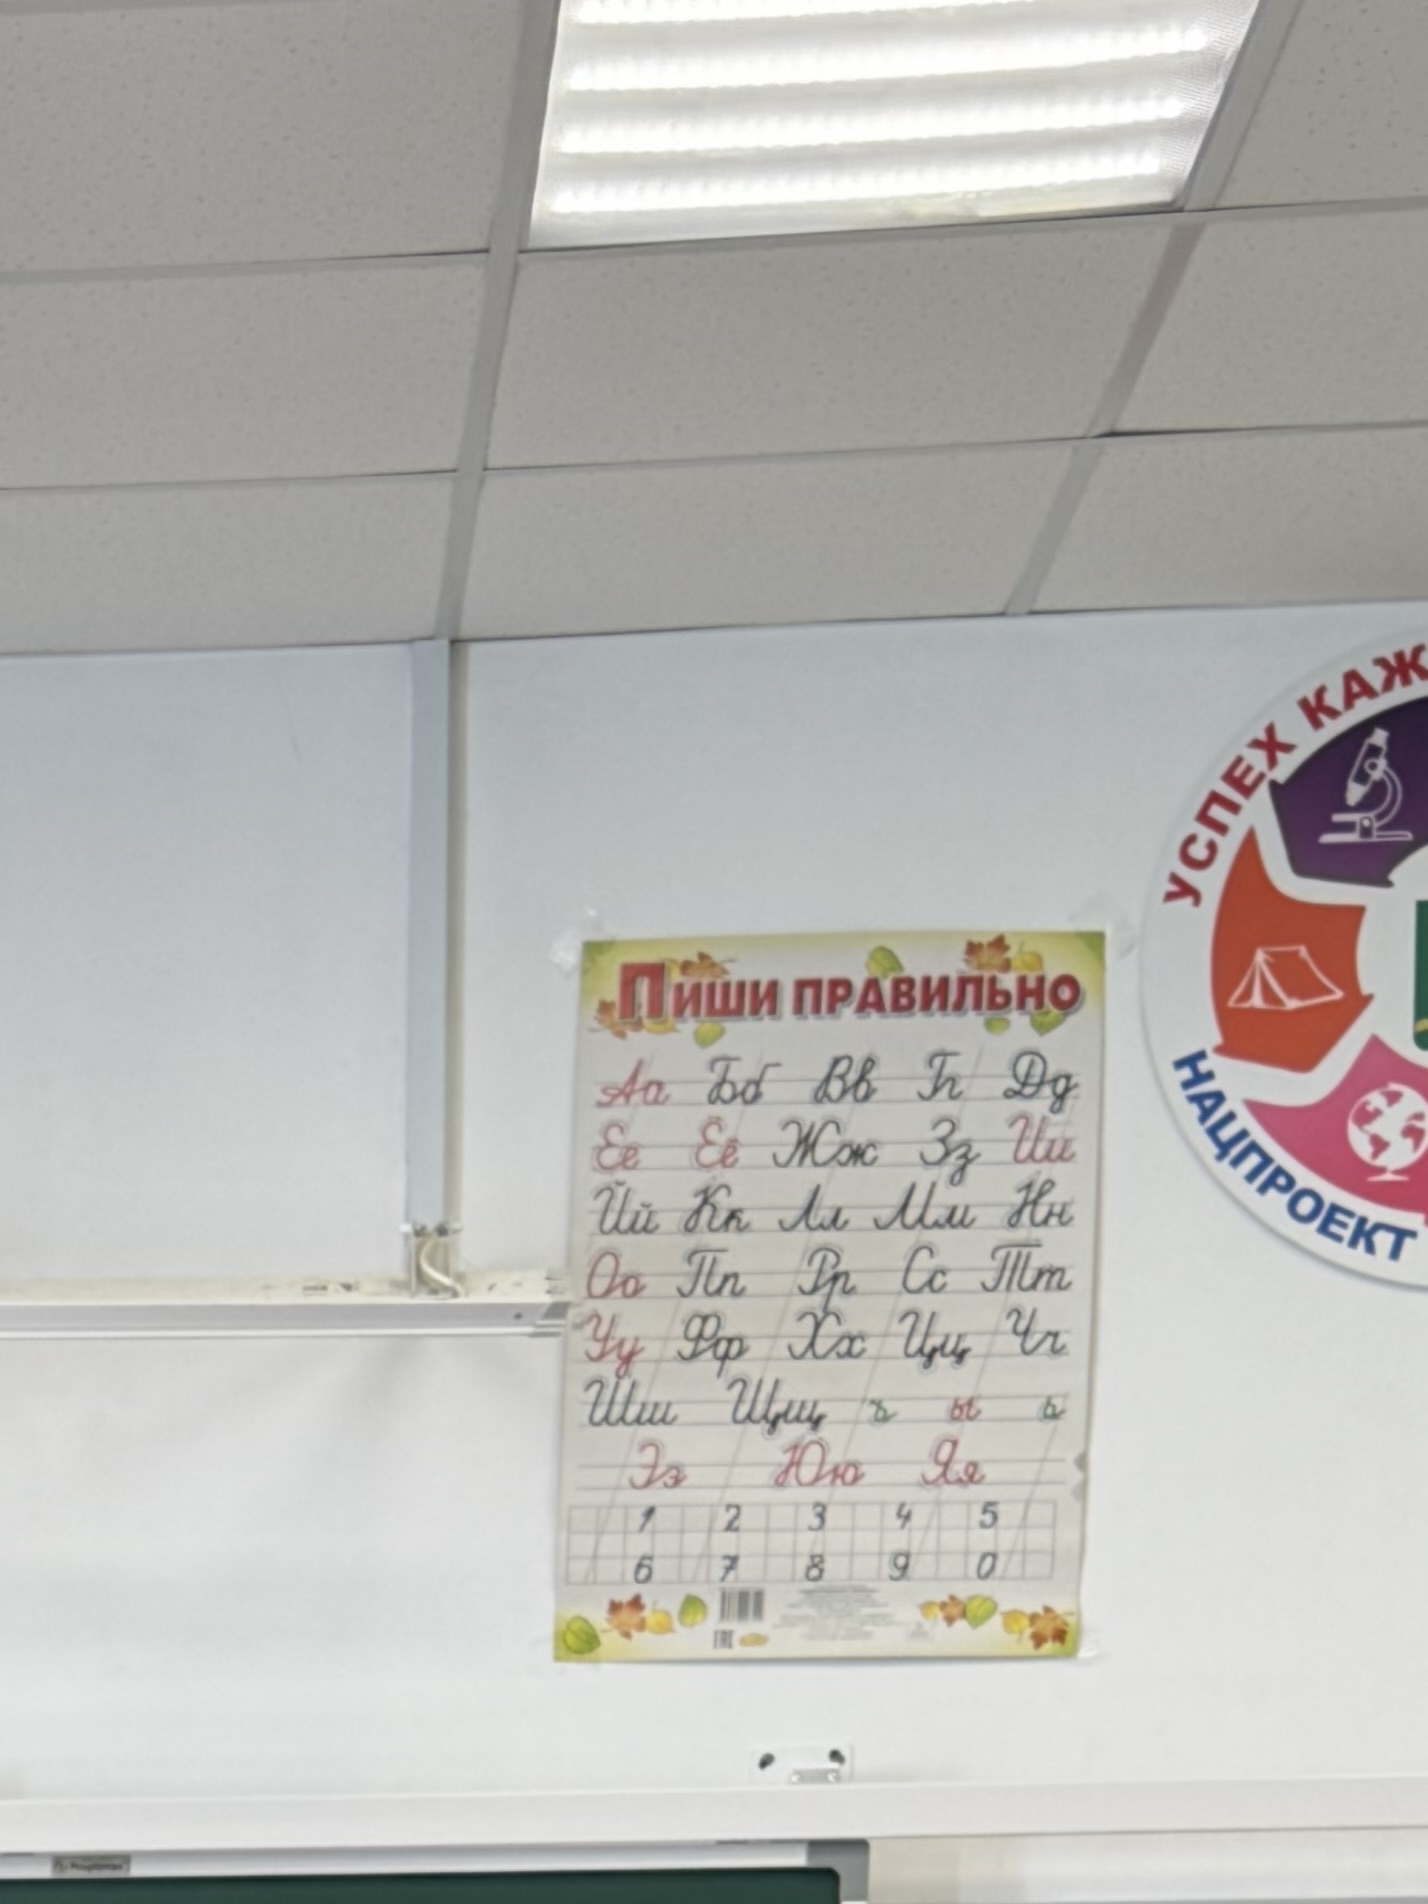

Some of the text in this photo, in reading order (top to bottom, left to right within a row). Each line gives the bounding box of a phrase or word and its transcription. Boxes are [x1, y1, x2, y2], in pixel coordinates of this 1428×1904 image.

[1163, 721, 1297, 907] УСПЕХ
[792, 974, 1081, 1017] ПРАВИЛЬНО
[596, 1051, 1079, 1113] Аа Бб Вв Гг Дд
[594, 1116, 1076, 1186] Ее Ёё Жж Зз Ии
[1172, 1050, 1418, 1263] НАЦПРОЕКТ
[594, 1180, 1074, 1234] Йй Кк Лл Мм Нн
[585, 1244, 1071, 1312] Оо Пп Рр Сс Тт
[583, 1309, 1067, 1378] Уу Фф Хх Цц Чч
[583, 1380, 676, 1427] Шш
[727, 1378, 827, 1436] Щщ
[629, 1437, 985, 1491] Ээ Юю Яя
[638, 1503, 999, 1535] 1 2 3 4 5
[633, 1553, 998, 1584] 6 7 8 9 0
